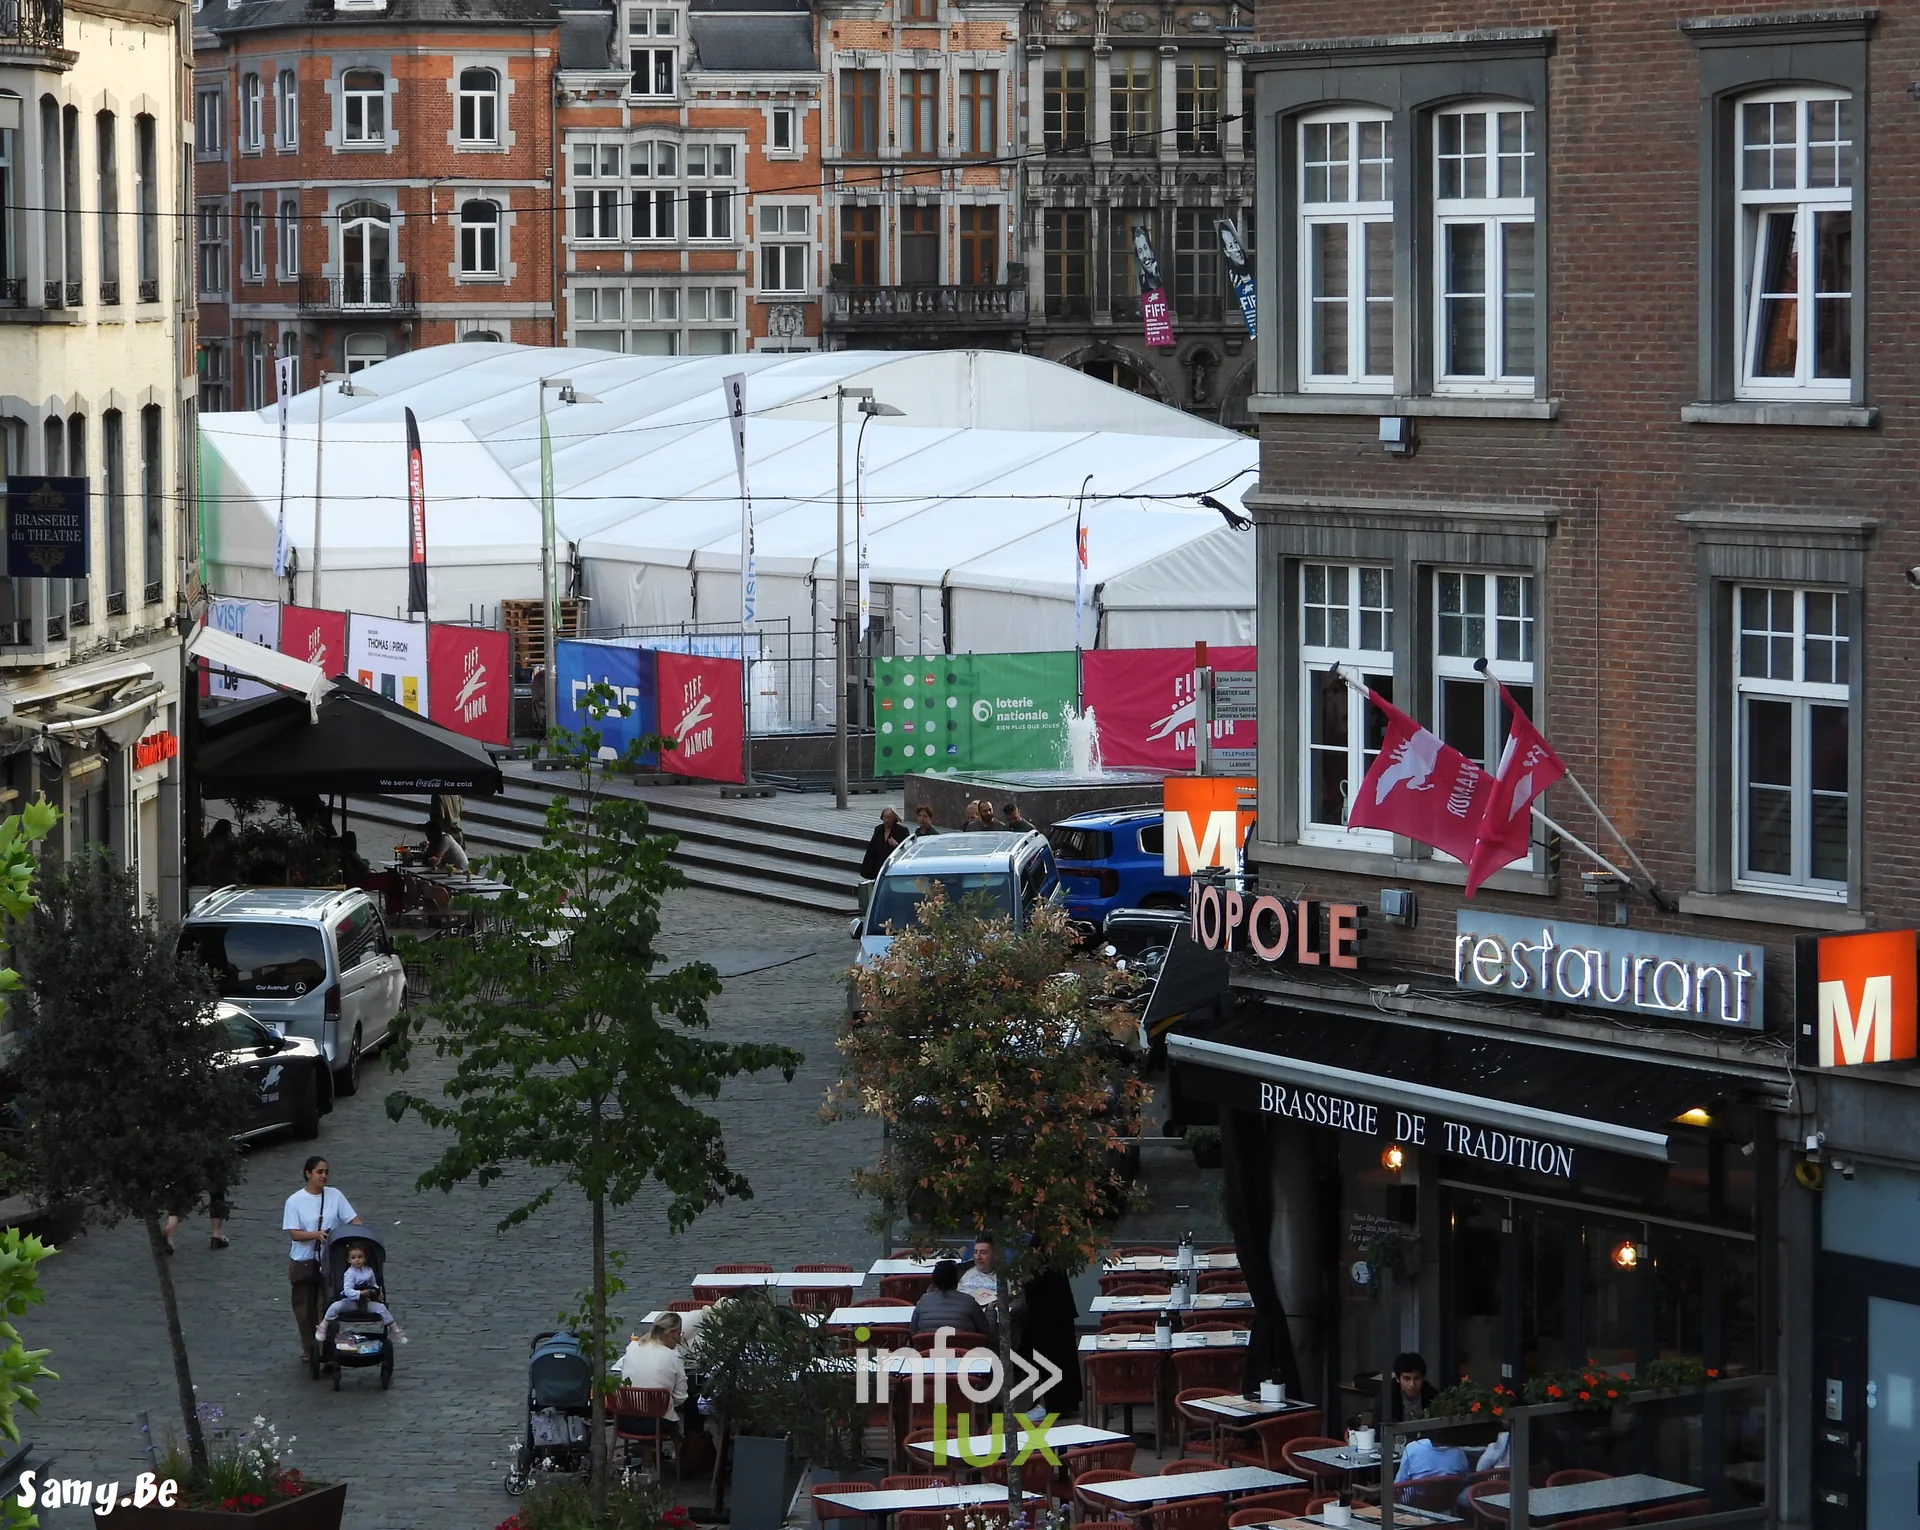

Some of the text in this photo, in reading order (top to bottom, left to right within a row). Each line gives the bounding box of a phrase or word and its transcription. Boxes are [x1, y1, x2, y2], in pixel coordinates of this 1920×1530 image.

[1144, 303, 1167, 318] FIFF
[14, 513, 79, 527] BRASSERIE
[11, 529, 82, 542] du THEATRE
[214, 603, 246, 633] VISIT
[308, 626, 321, 652] FIFF
[367, 638, 389, 651] THOMAS
[392, 640, 408, 653] PIRON
[464, 646, 479, 673] FIFF
[683, 675, 702, 704] FIFF
[996, 697, 1034, 709] loterie
[464, 694, 488, 724] NAMUR
[996, 709, 1049, 722] nationale
[684, 726, 714, 758] NAMUR
[1164, 811, 1237, 876] M
[1455, 928, 1754, 1023] restaurant
[1818, 975, 1893, 1067] M
[1259, 1082, 1575, 1178] BRASSERIE DE TRADITION
